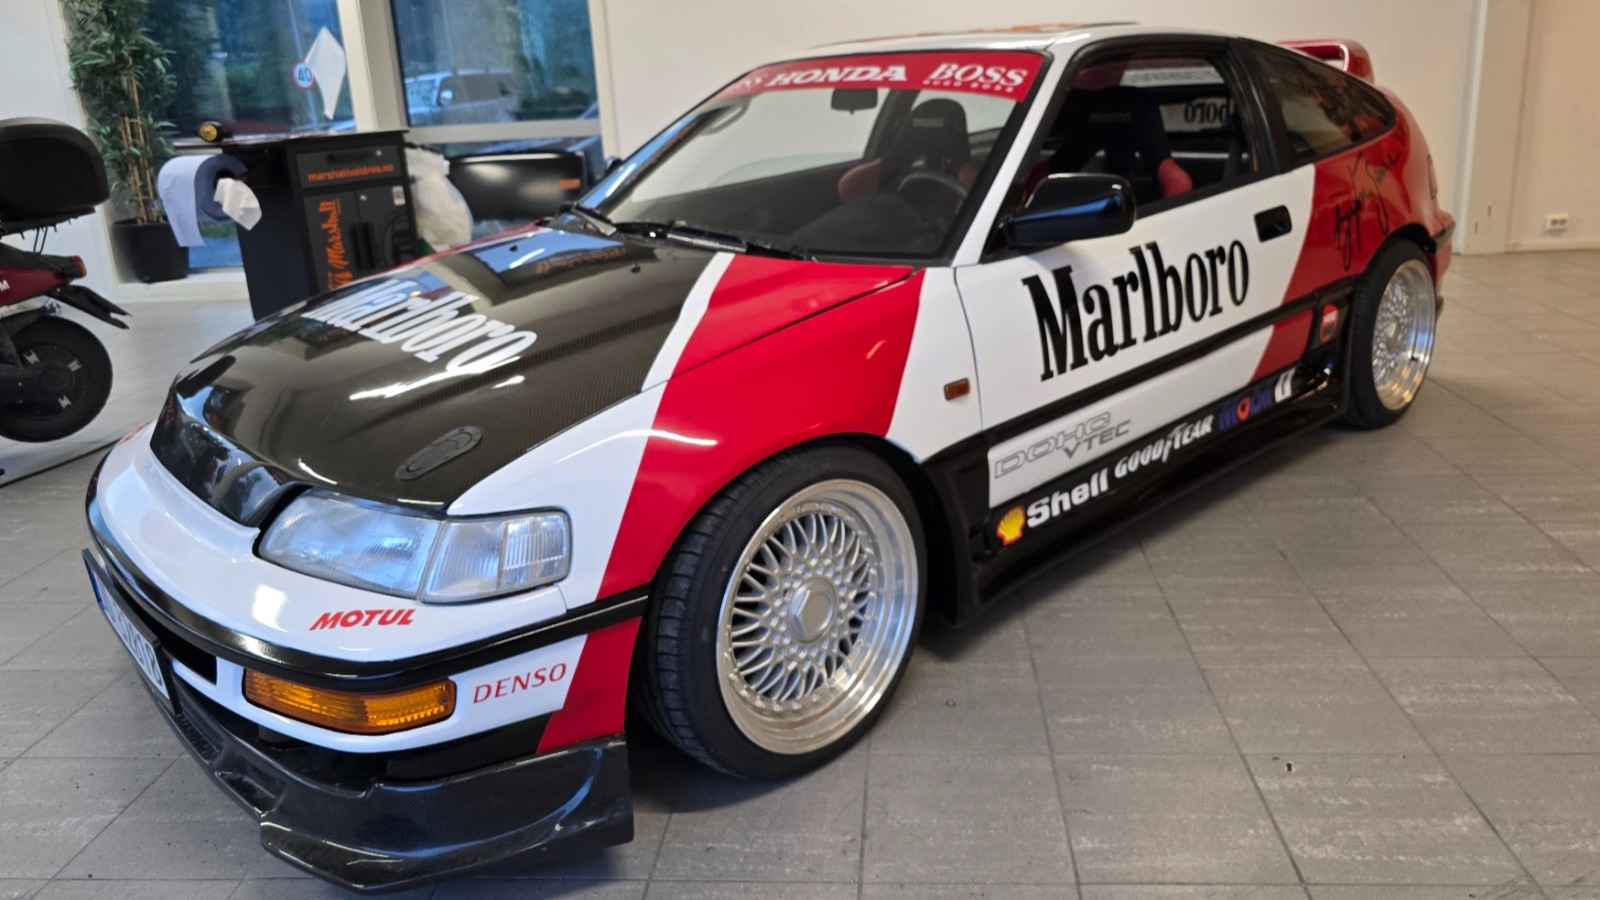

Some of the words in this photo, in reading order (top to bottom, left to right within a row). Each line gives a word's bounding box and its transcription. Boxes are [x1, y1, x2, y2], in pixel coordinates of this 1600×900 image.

[298, 67, 312, 82] 40
[765, 65, 908, 87] HONDA
[929, 63, 1028, 87] BOSS
[307, 164, 394, 182] marshallvaldres.no
[300, 279, 538, 373] Marlboro
[1021, 240, 1249, 382] Marlboro
[994, 411, 1111, 479] DOHC
[1062, 419, 1131, 459] VTEC
[1027, 467, 1108, 528] Shell
[1114, 414, 1214, 479] GOODYEAR
[308, 609, 416, 631] MOTUL
[473, 662, 568, 704] DENSO
